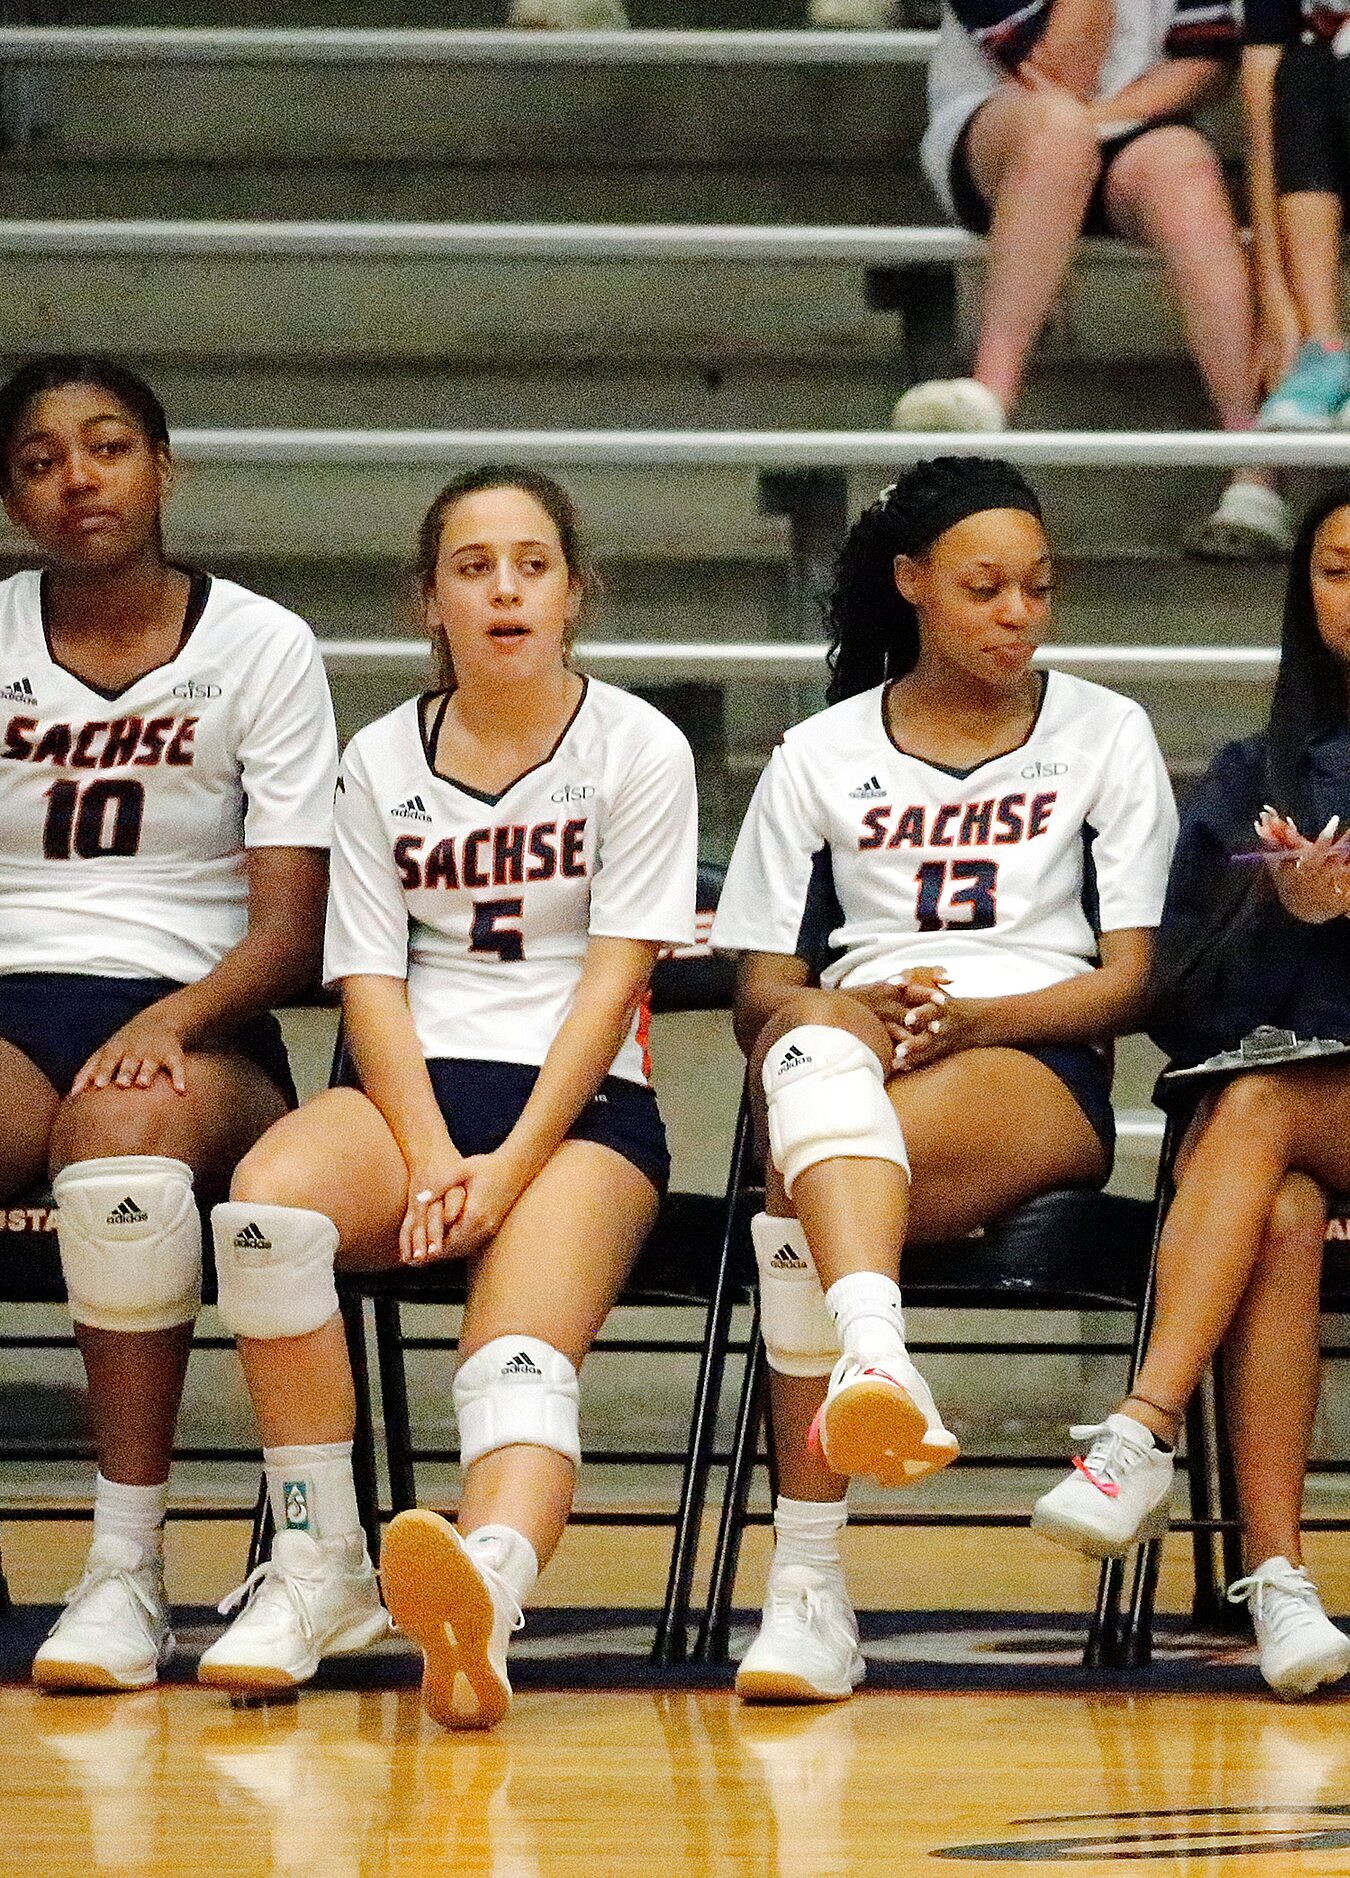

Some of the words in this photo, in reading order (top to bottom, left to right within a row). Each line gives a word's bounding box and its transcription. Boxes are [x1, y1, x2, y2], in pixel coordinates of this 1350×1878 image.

[2, 715, 200, 769] SACHSE
[42, 778, 145, 860] 10
[858, 791, 1058, 852] SACHSE
[393, 817, 588, 891] SACHSE
[914, 858, 1000, 932] 13
[468, 897, 526, 962] 5
[106, 1211, 149, 1224] adidas
